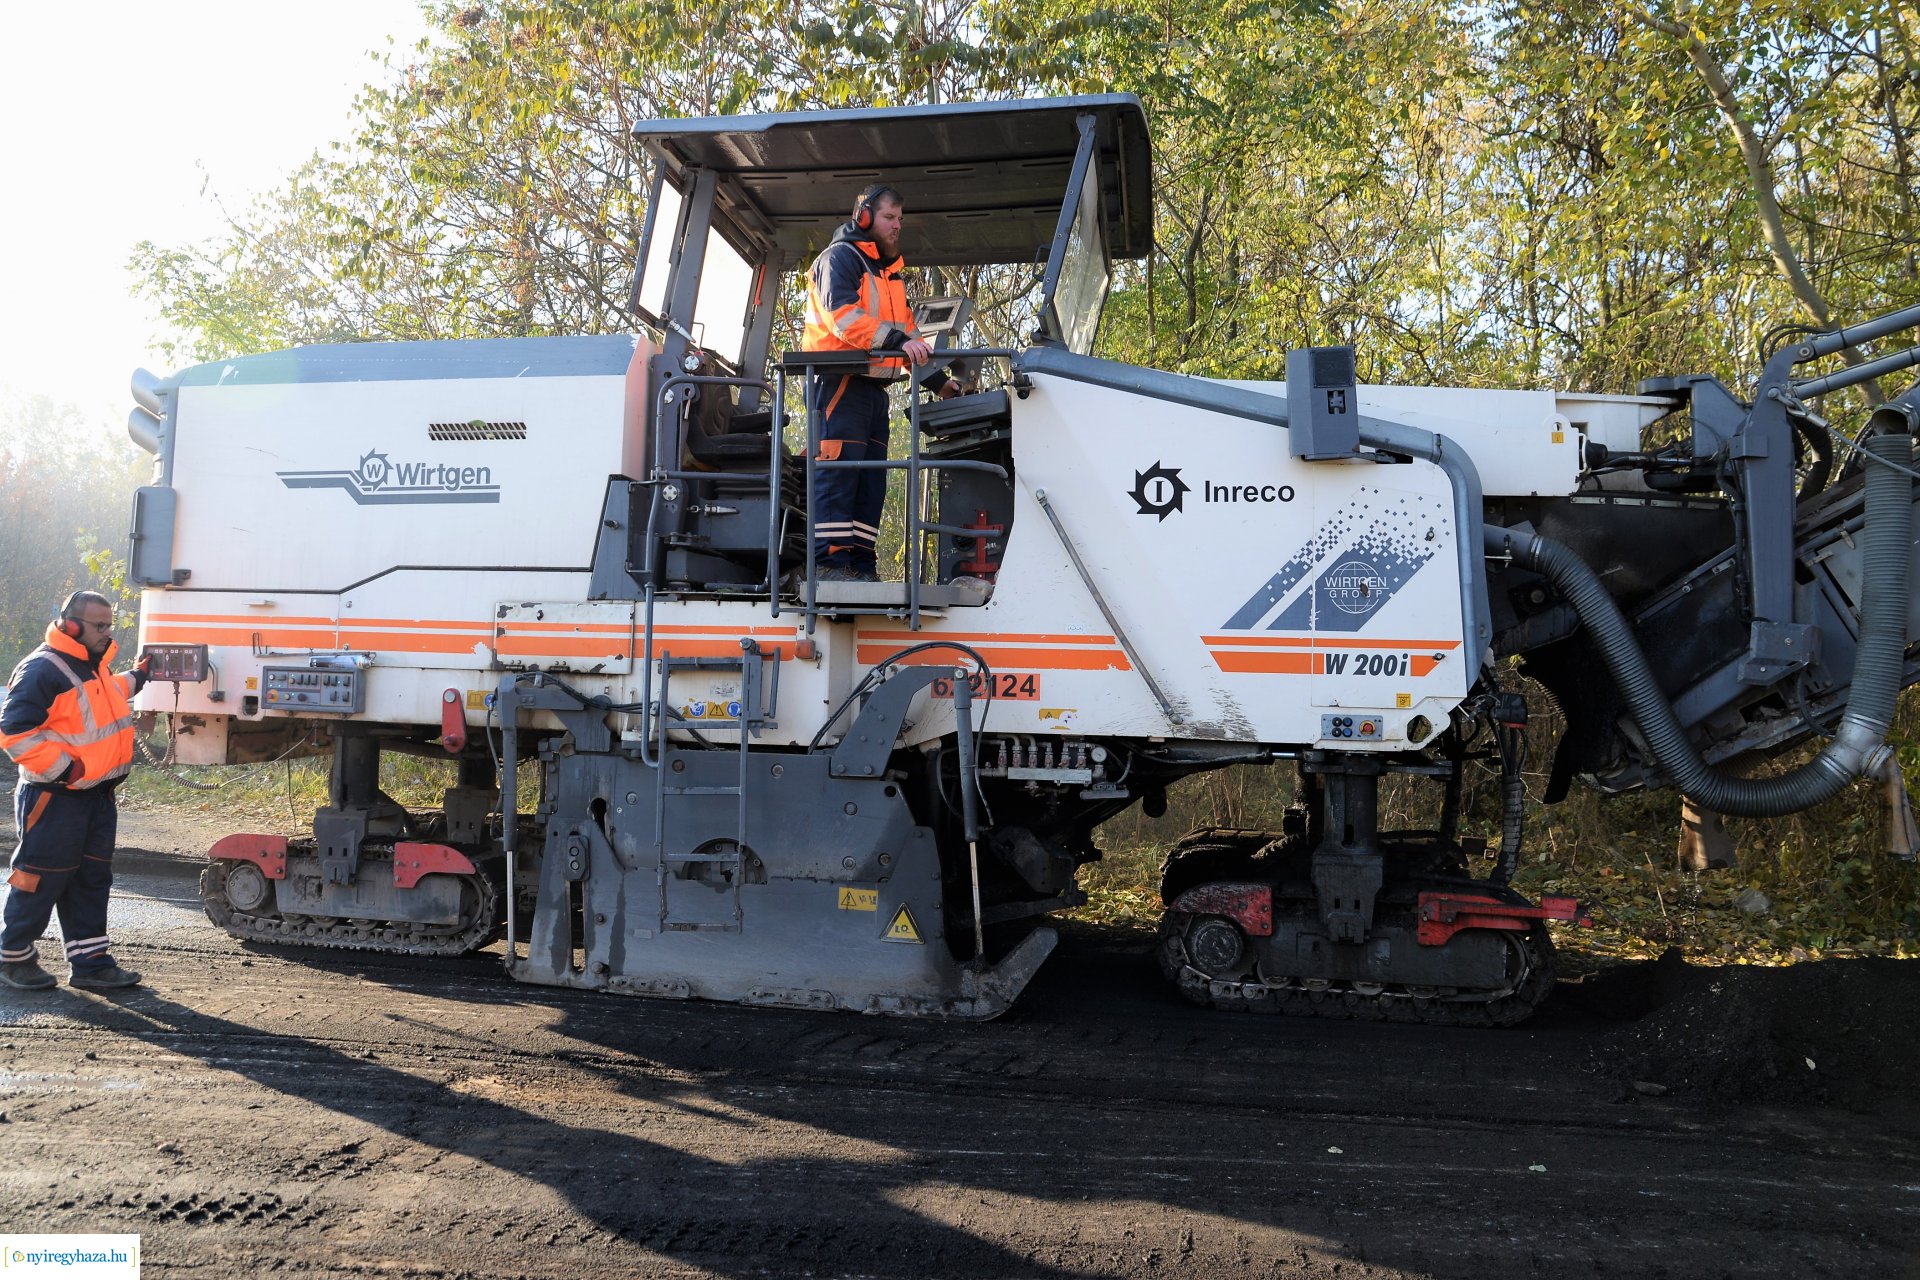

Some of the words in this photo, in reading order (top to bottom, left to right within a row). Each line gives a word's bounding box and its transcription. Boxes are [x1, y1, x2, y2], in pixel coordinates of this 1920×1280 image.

[366, 463, 382, 479] W
[396, 462, 491, 491] Wirtgen
[1204, 480, 1295, 503] Inreco
[1325, 653, 1349, 675] W
[1352, 652, 1409, 677] 200i
[933, 674, 1037, 698] 62124
